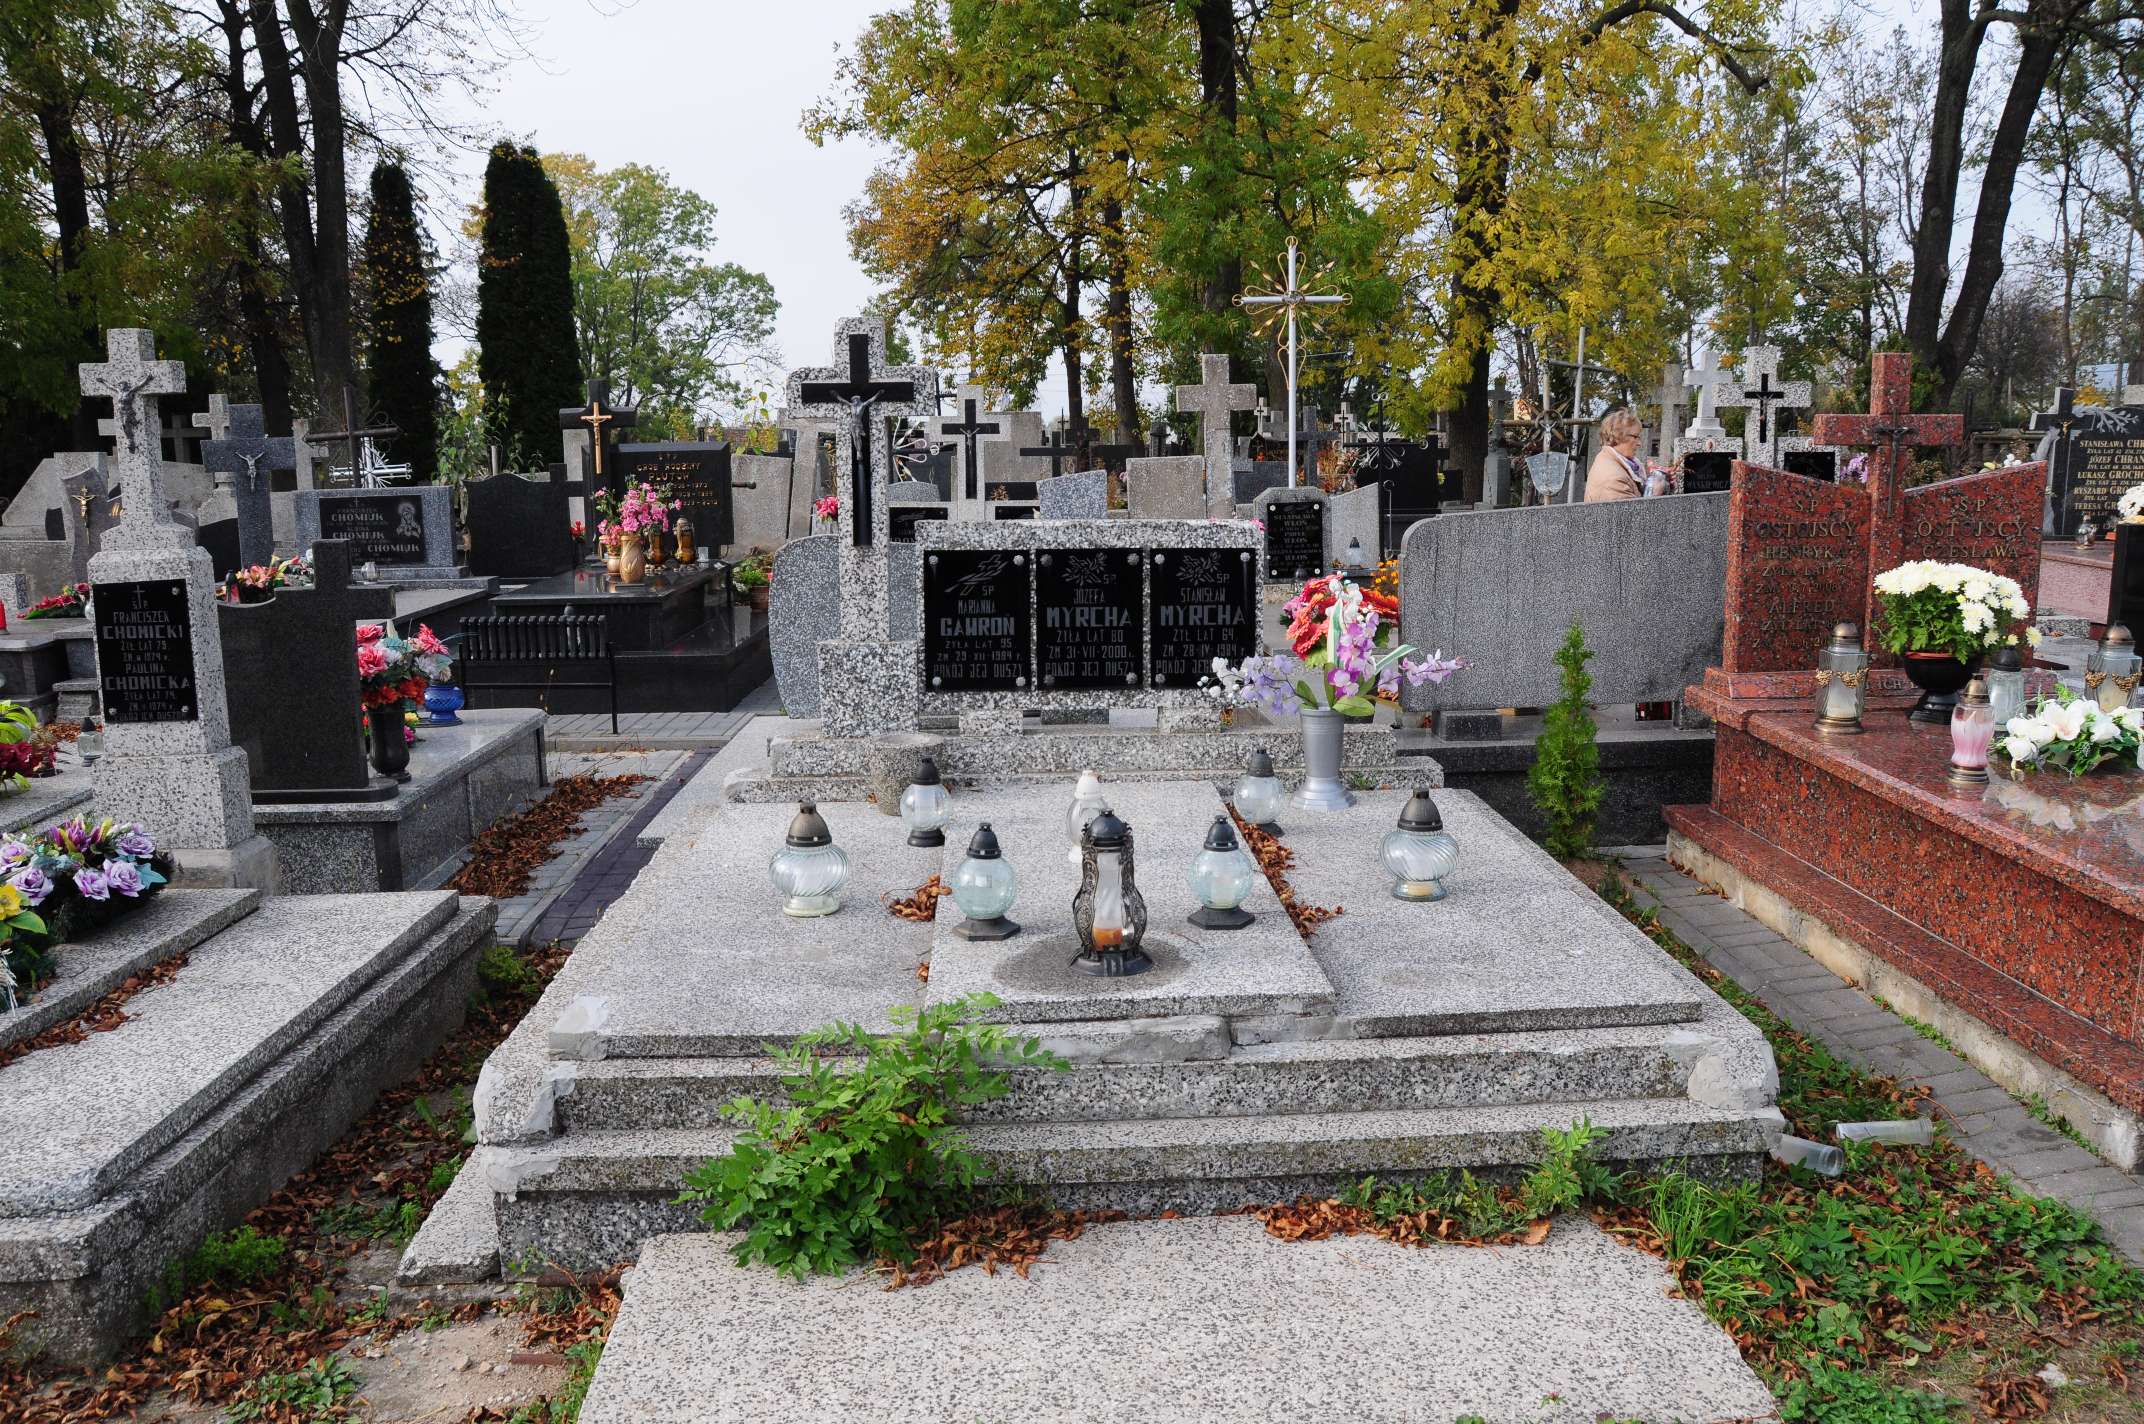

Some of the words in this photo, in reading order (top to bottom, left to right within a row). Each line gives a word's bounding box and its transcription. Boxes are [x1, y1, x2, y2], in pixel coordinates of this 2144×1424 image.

[1918, 521, 2028, 537] OSTOJSCY
[113, 610, 170, 623] FRANCISZEK
[1046, 606, 1132, 628] MYRCHA
[1160, 604, 1246, 626] MYRCHA
[102, 624, 183, 640] CHOMICKI
[125, 663, 166, 674] PAULINA
[105, 675, 191, 690] CHOMICKA
